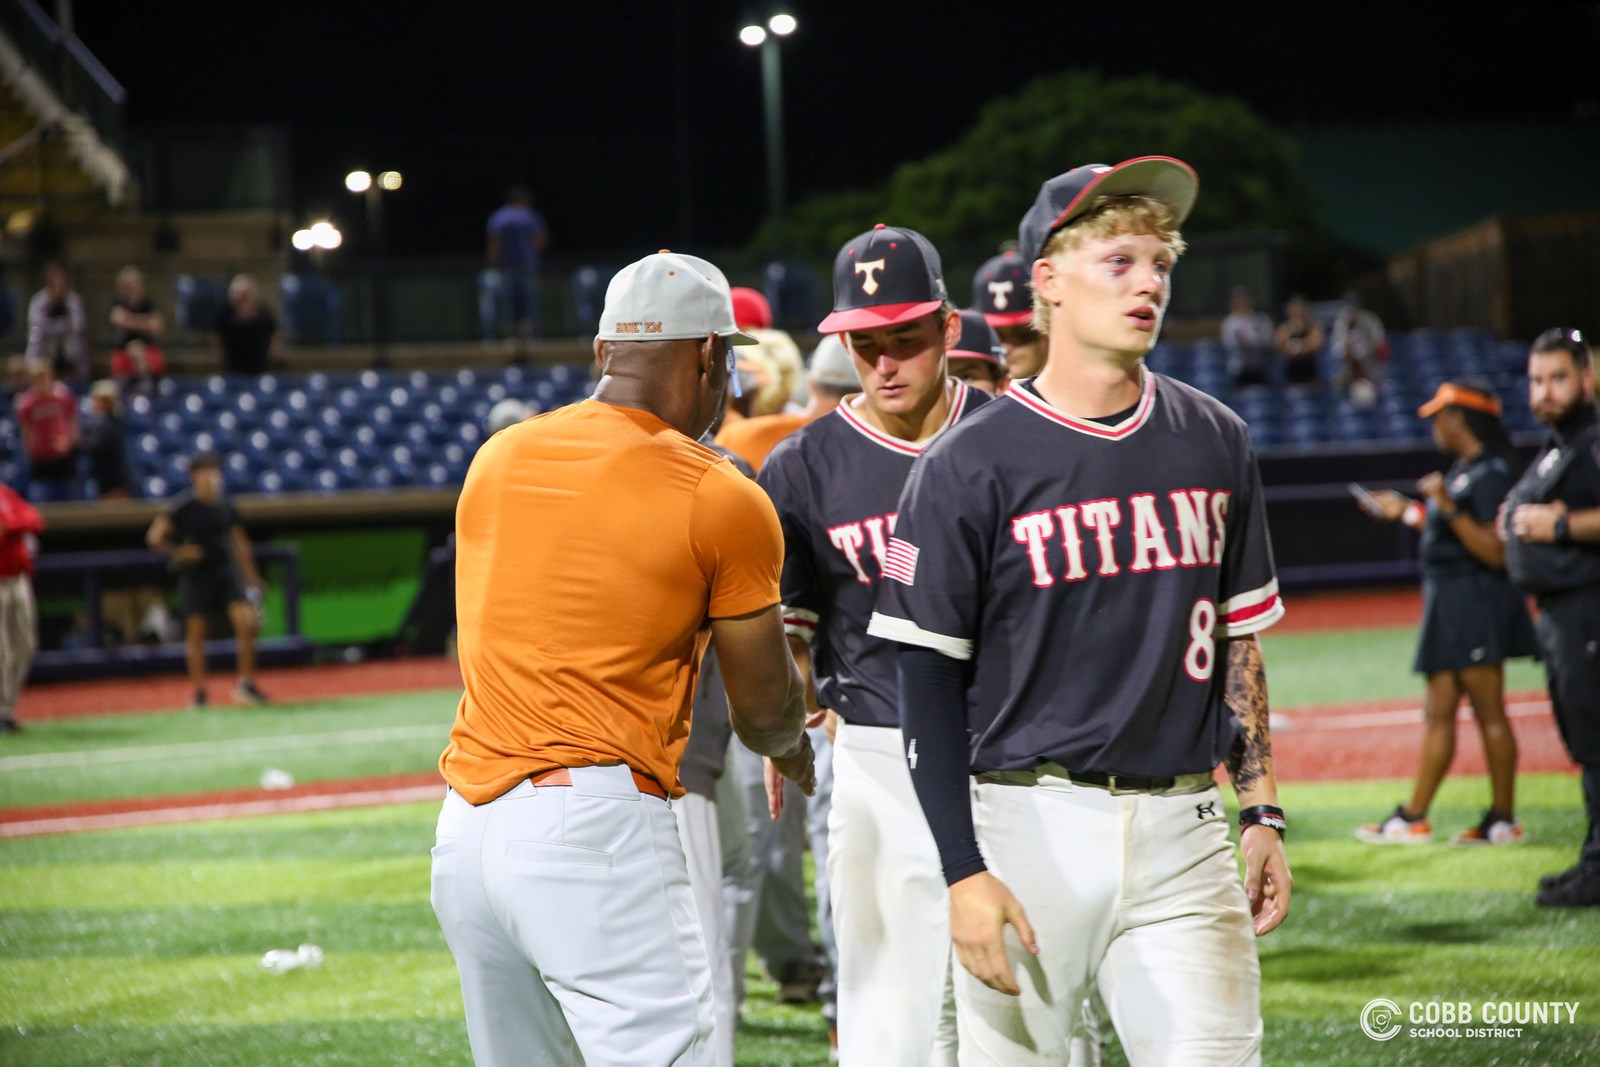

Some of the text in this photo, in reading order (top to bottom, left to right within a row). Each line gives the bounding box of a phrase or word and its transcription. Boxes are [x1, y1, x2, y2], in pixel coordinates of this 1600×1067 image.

[854, 257, 886, 297] T
[1010, 487, 1232, 588] TITANS
[1184, 597, 1217, 683] 8
